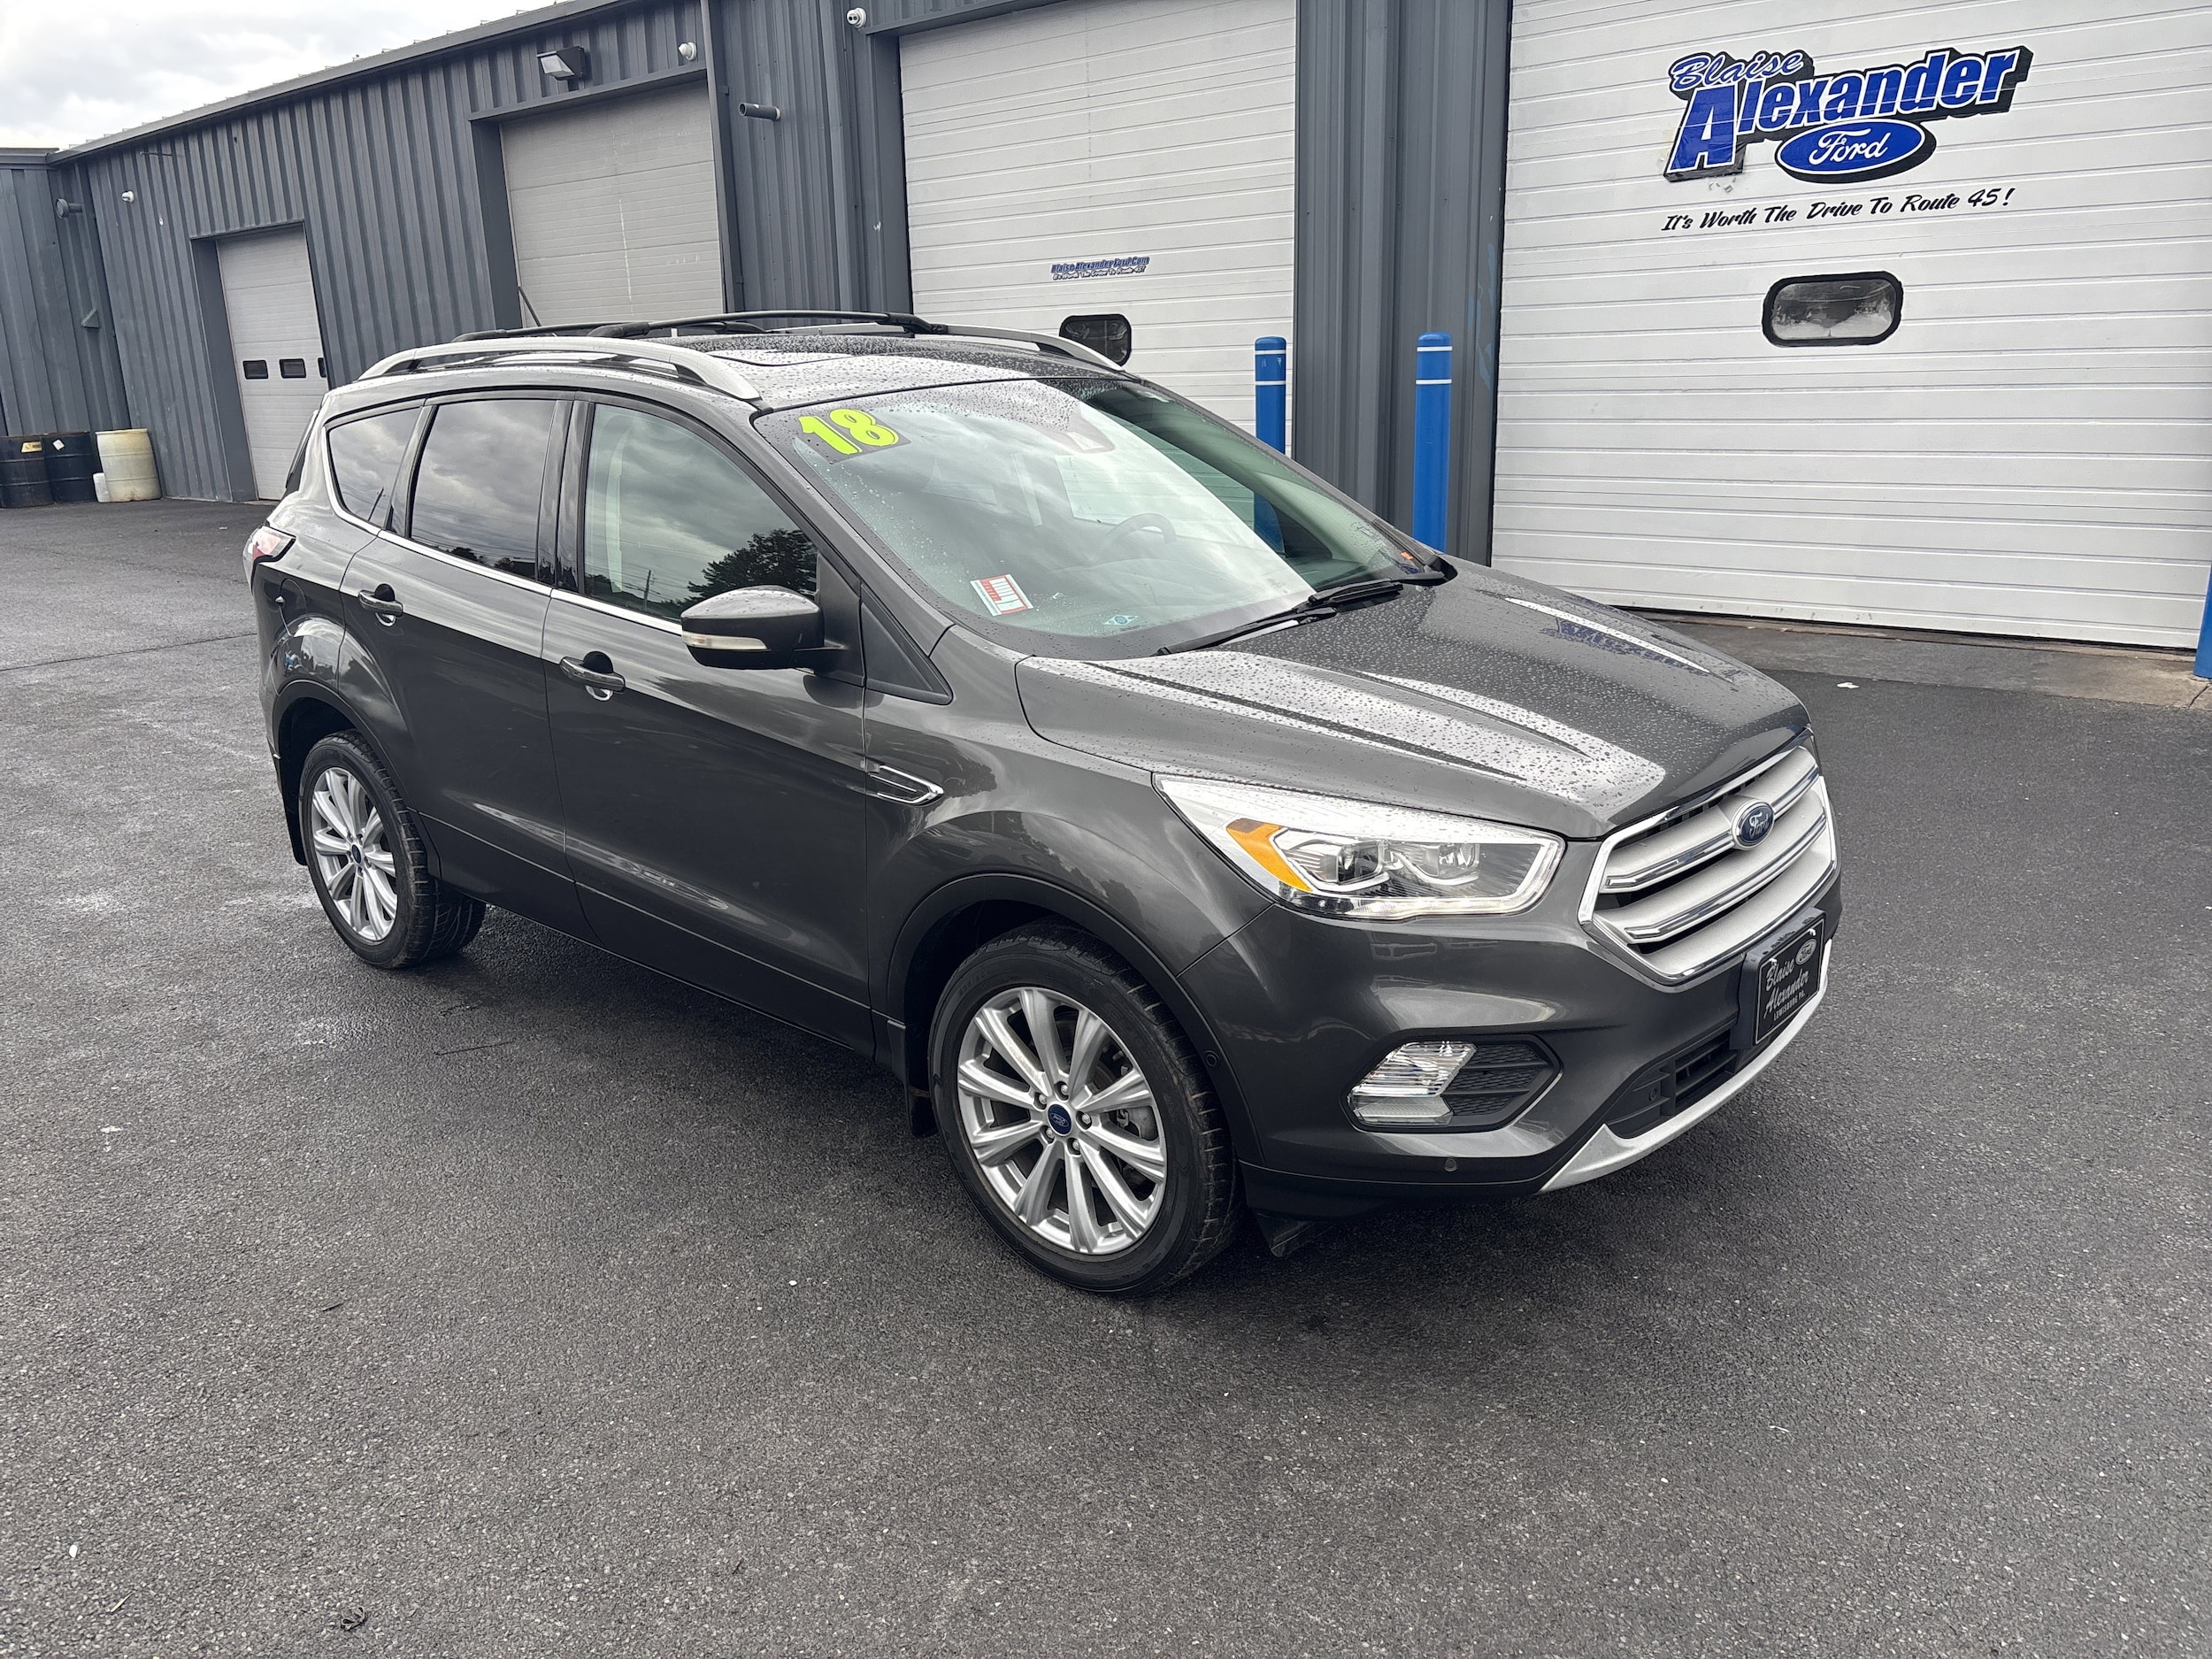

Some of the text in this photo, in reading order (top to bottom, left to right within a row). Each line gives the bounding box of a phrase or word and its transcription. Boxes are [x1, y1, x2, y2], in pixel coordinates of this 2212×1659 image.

[1671, 50, 1805, 92] Blaise
[1667, 48, 2024, 175] Alexander
[1808, 127, 1890, 165] Ford
[1661, 214, 1694, 231] It's
[1699, 207, 1758, 229] Worth
[1763, 204, 1797, 223] The
[1806, 202, 1863, 219] Drive
[1870, 196, 1893, 215] To
[1900, 193, 1961, 212] Route
[798, 408, 900, 455] 18
[1748, 811, 1770, 840] Ford
[1763, 967, 1809, 1020] Alexander
[1765, 958, 1795, 992] Blaise
